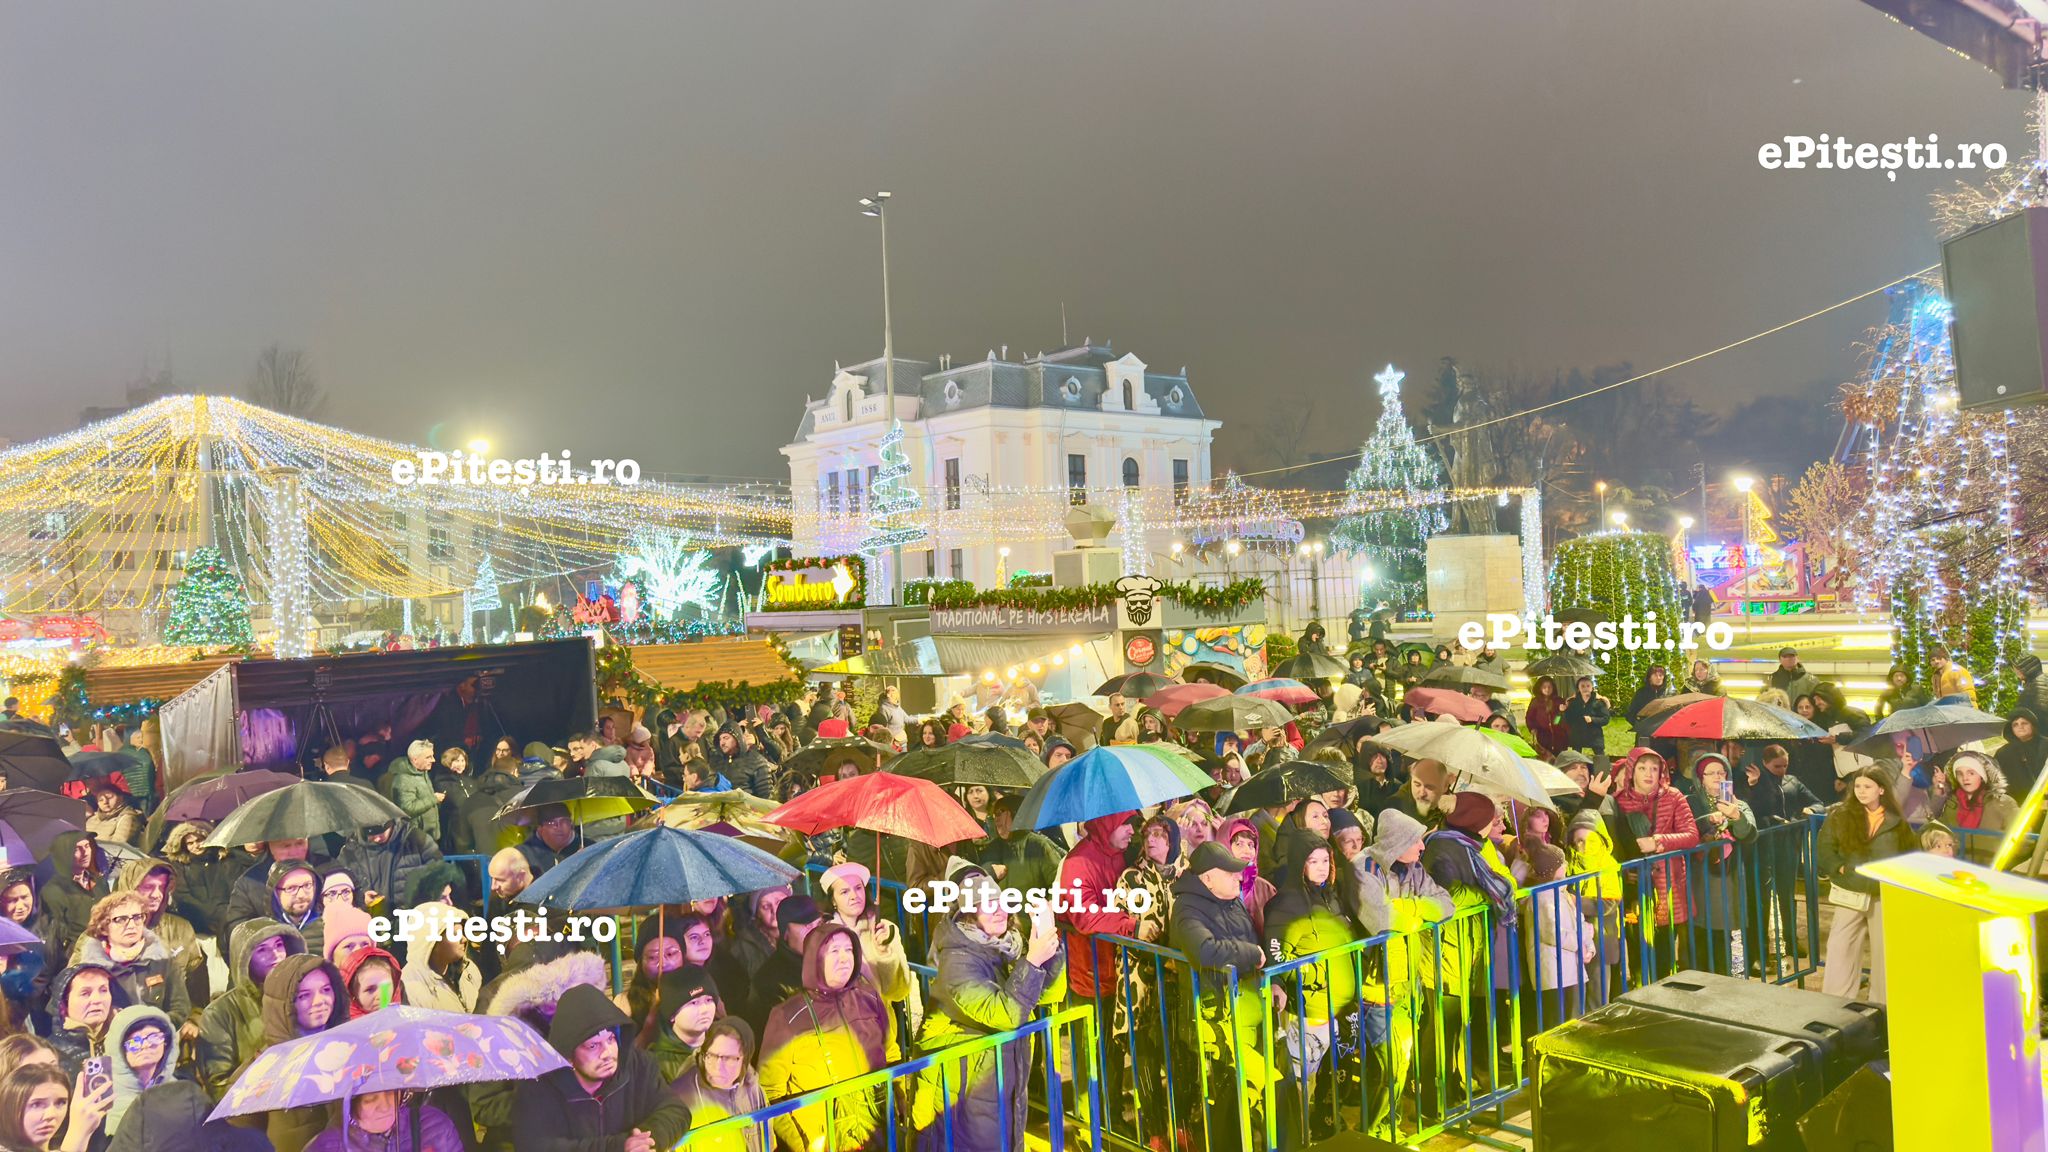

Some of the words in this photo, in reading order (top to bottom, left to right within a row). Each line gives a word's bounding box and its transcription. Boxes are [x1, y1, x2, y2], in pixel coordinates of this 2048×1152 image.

[767, 574, 836, 603] Sombrero
[936, 610, 1005, 628] TRADITIONAL
[1009, 608, 1024, 626] PE
